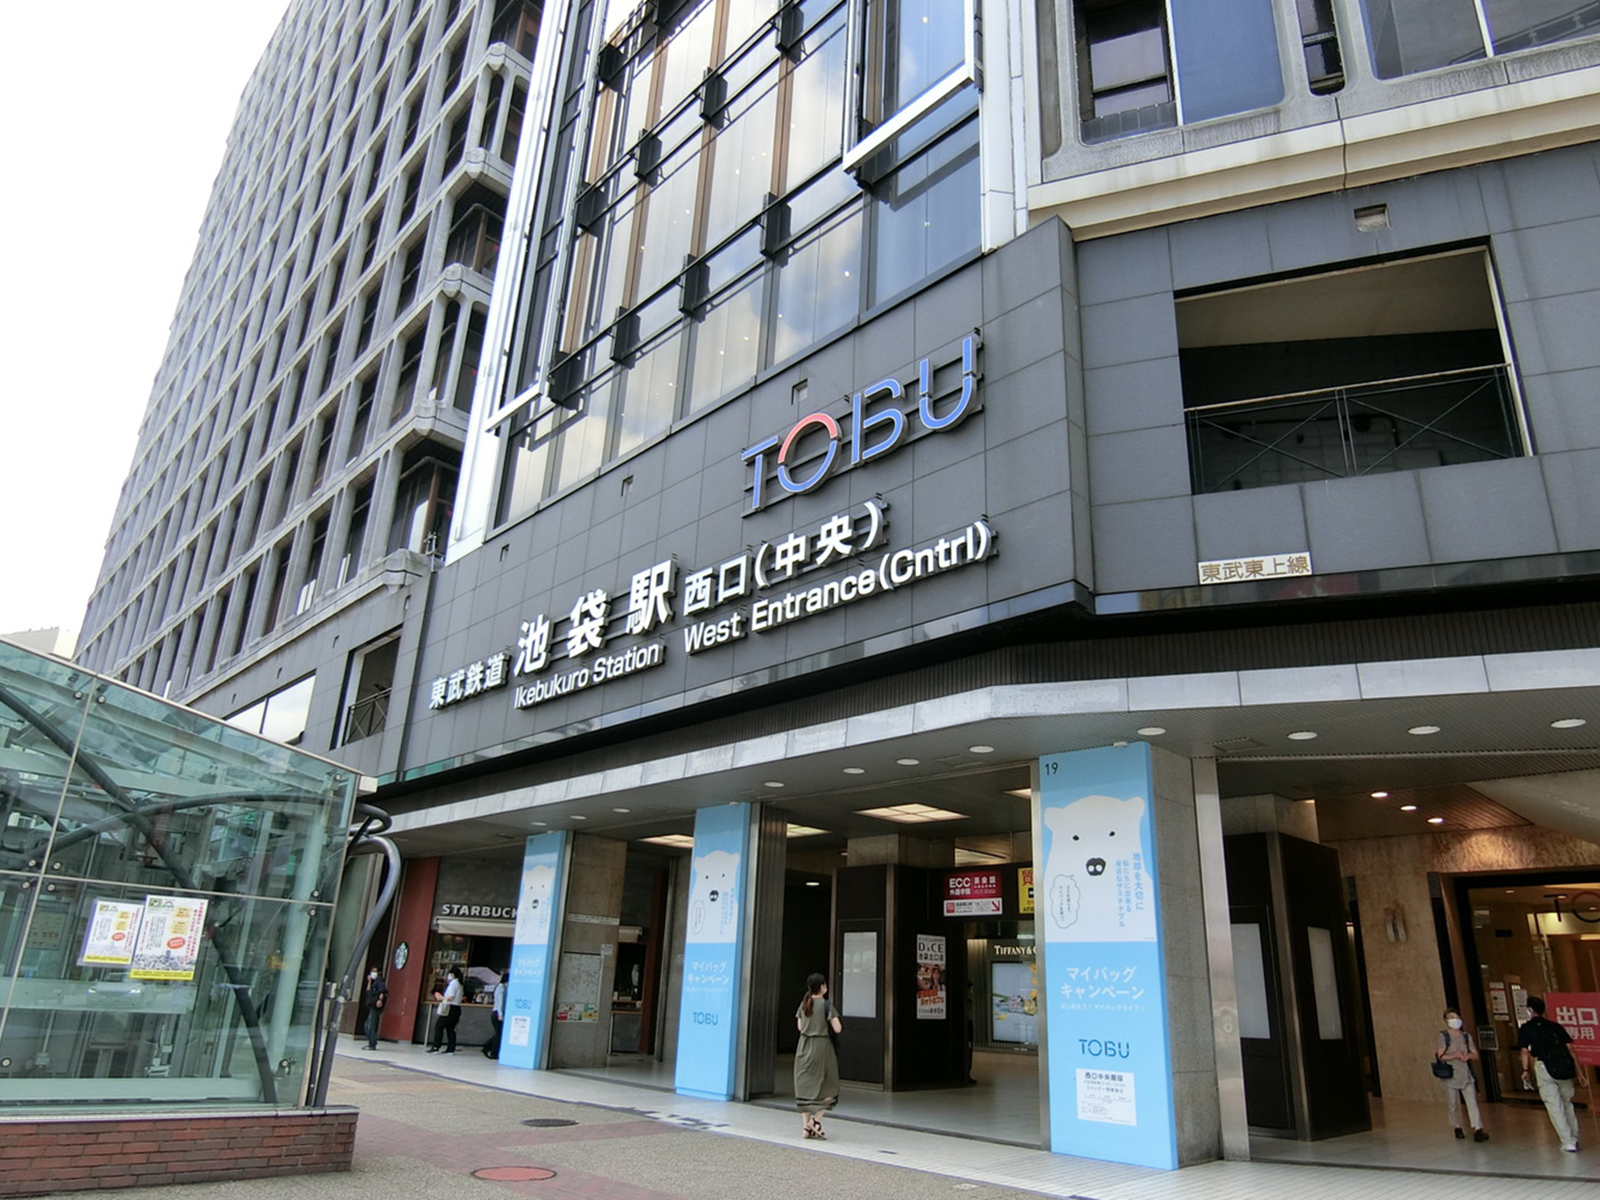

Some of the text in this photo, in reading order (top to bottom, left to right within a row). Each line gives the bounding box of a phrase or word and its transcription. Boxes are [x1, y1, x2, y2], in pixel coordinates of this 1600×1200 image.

[741, 335, 977, 510] TOBU
[1201, 555, 1310, 582] 東武東上線
[429, 652, 509, 709] 東武鉄道
[513, 559, 678, 677] 池袋駅
[514, 668, 590, 710] Ikebukuro
[593, 643, 663, 683] Station
[683, 612, 742, 654] West
[1044, 762, 1059, 776] 19
[949, 877, 971, 888] ECC
[1132, 852, 1144, 911] 地球を大切に
[692, 961, 728, 972] マイバッグ
[1066, 966, 1138, 983] マイバッグ
[1060, 982, 1145, 1000] キャンペーン
[692, 1011, 719, 1026] TOBU
[1555, 1006, 1599, 1026] 出口
[1078, 1038, 1130, 1059] TOBU
